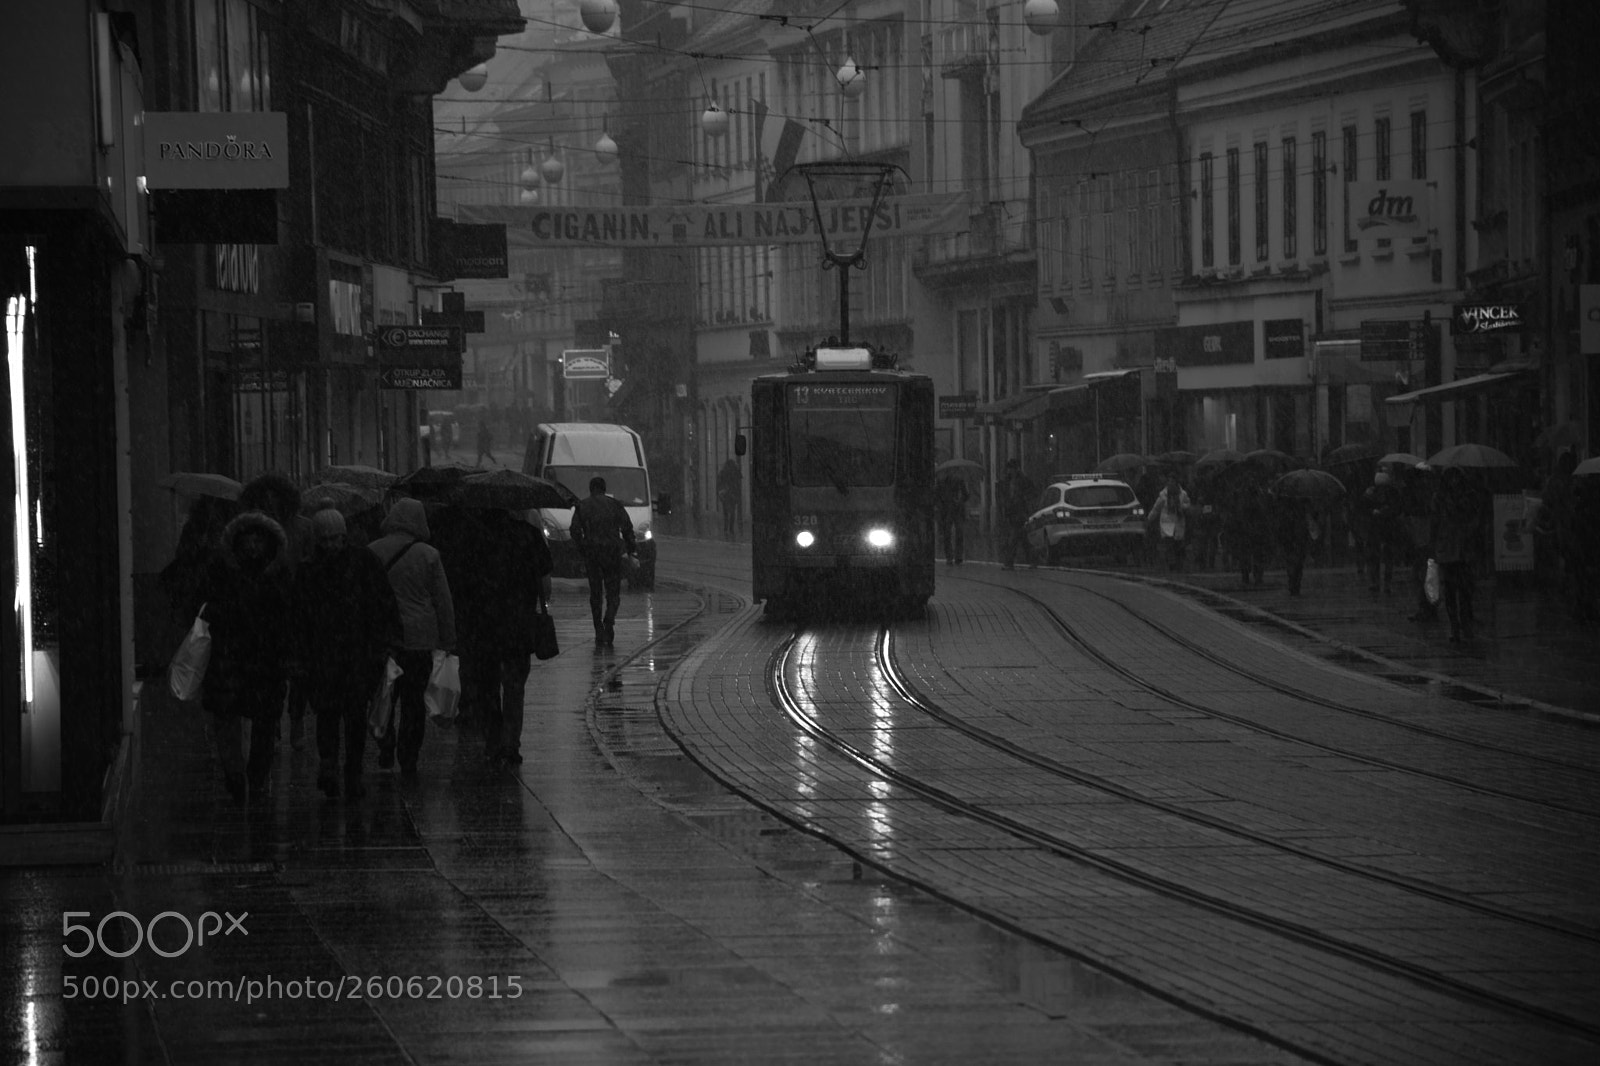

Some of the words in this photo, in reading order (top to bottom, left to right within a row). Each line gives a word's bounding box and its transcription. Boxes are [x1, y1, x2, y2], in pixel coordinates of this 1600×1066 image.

[159, 141, 274, 160] PANDORA
[1368, 189, 1413, 215] dm
[531, 211, 659, 242] CIGANIN,
[704, 209, 742, 239] ALI
[1461, 305, 1519, 326] VINCEK
[421, 368, 446, 377] ZLATA
